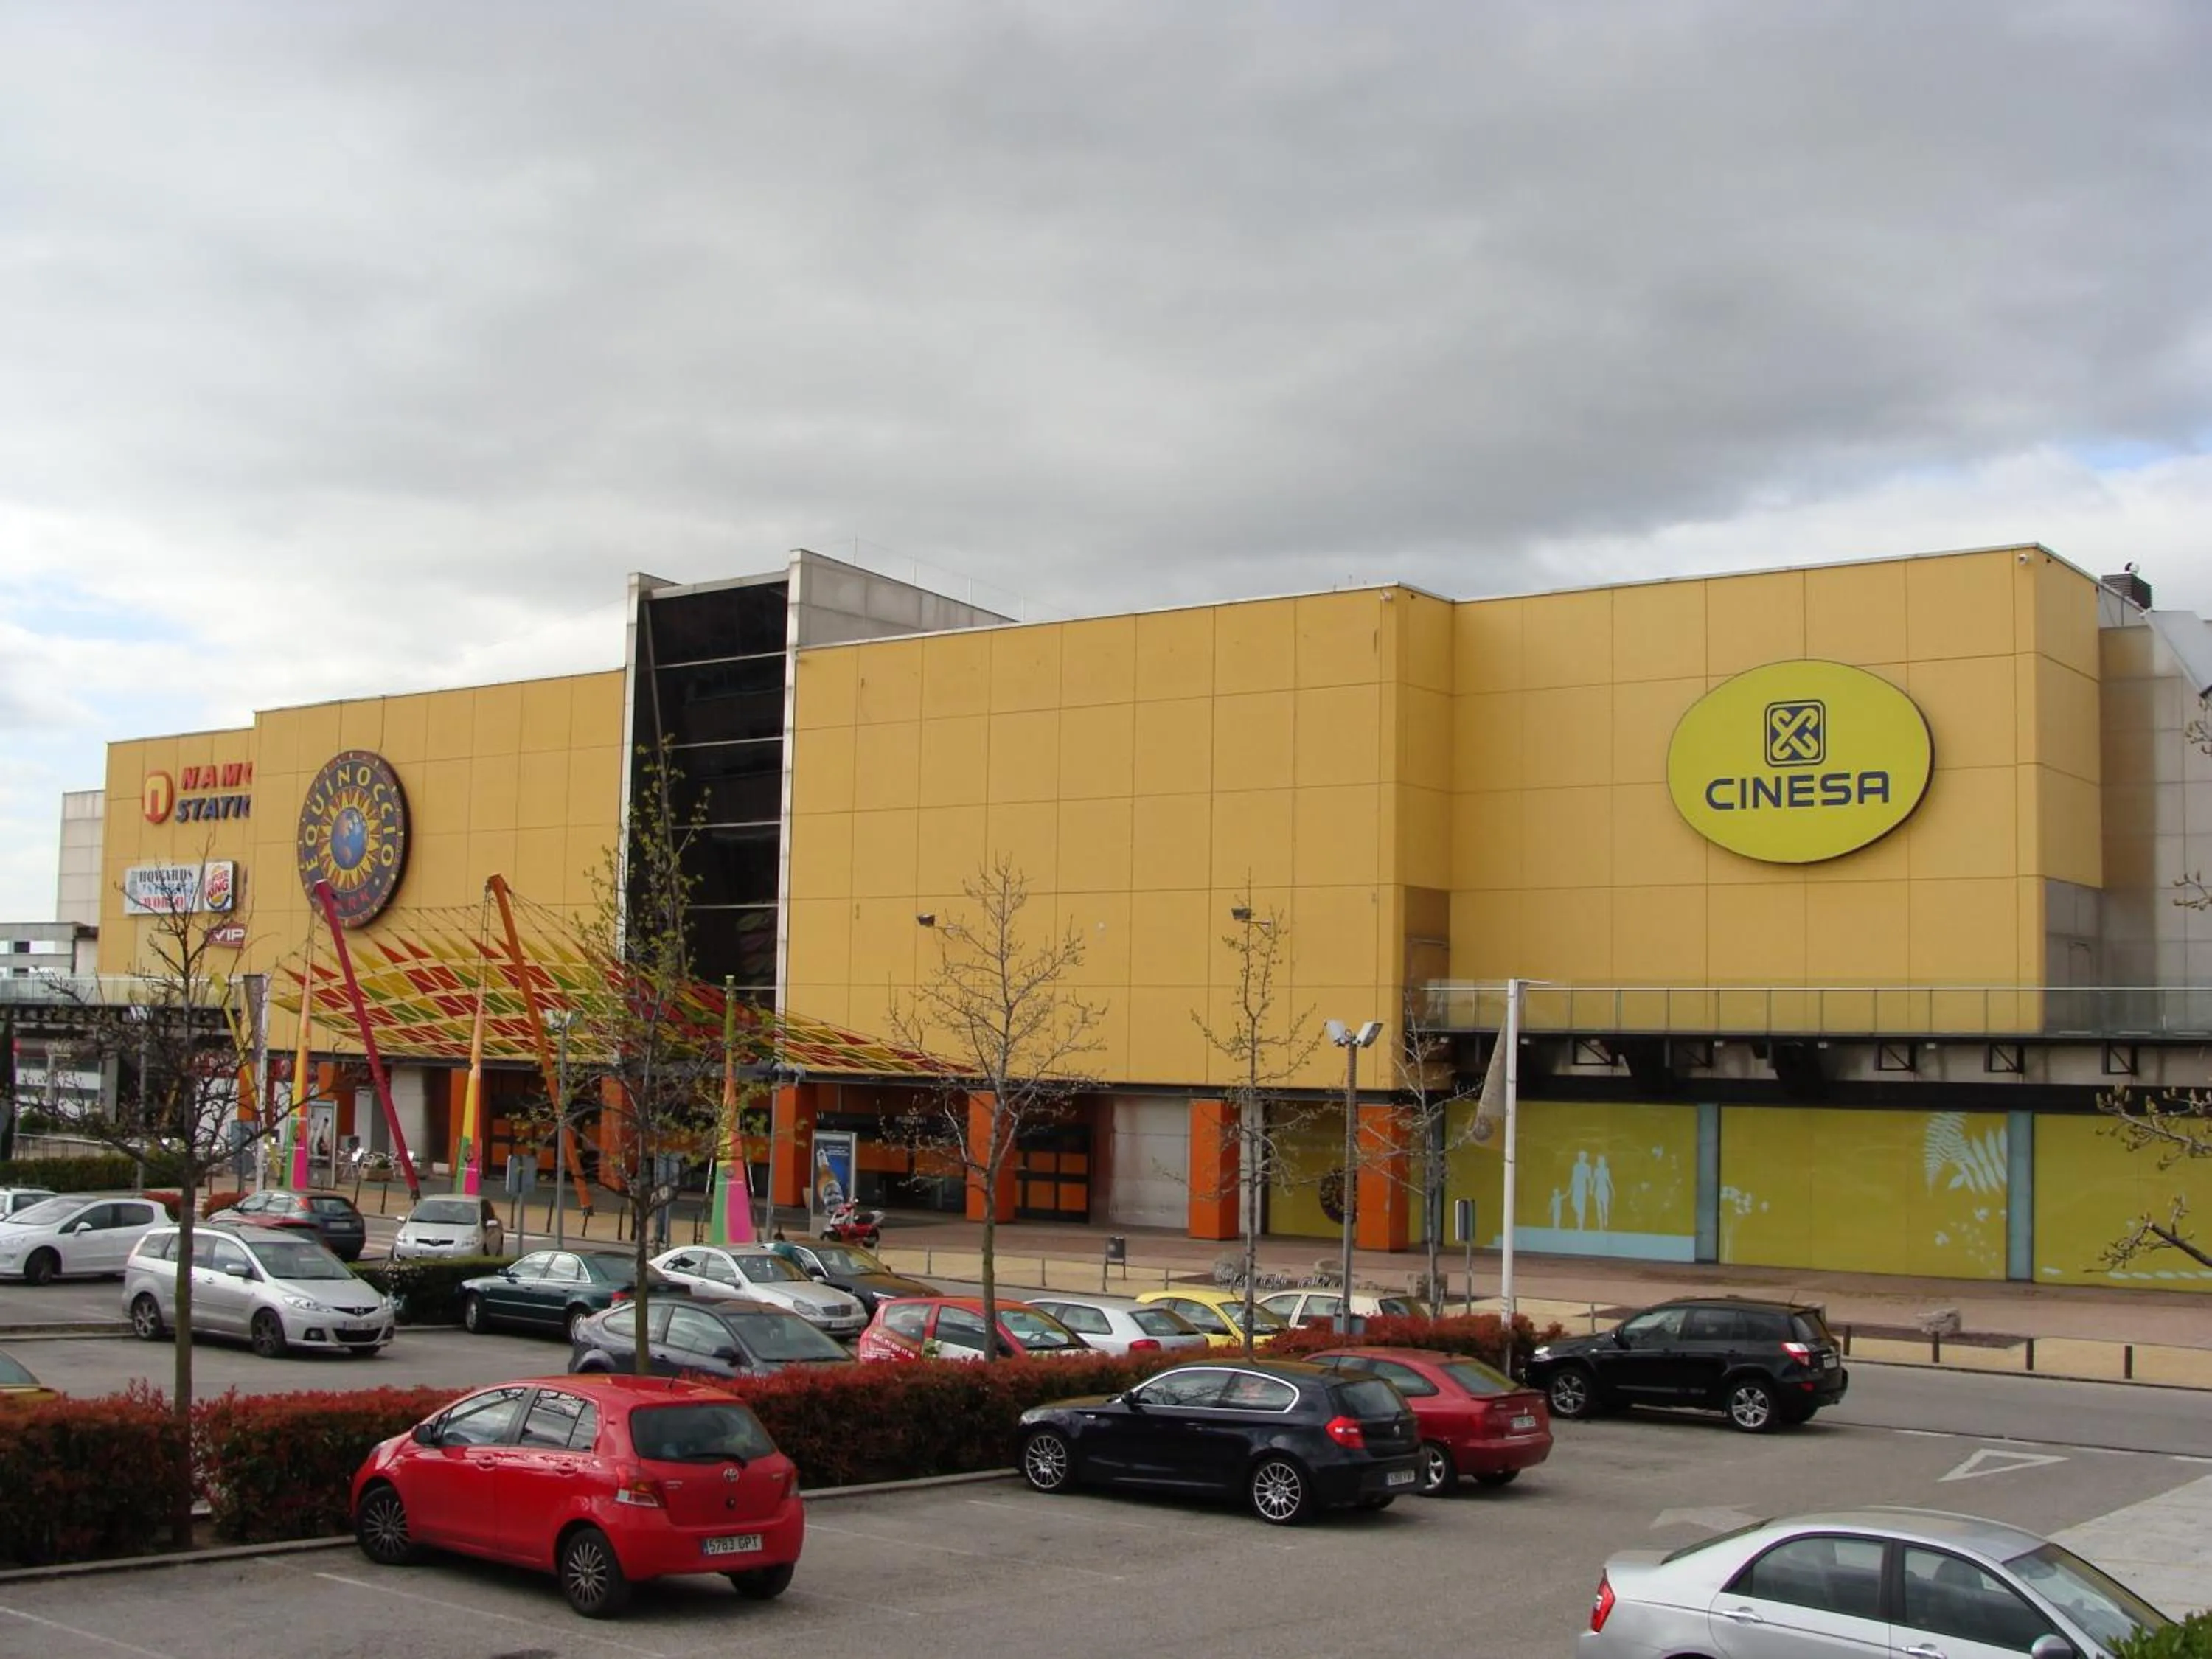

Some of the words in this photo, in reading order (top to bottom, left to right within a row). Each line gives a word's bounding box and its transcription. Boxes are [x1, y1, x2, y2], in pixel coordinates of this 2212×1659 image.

[1705, 771, 1890, 810] CINESA
[305, 764, 396, 872] EQUINOCCIO
[708, 1537, 735, 1553] 5783
